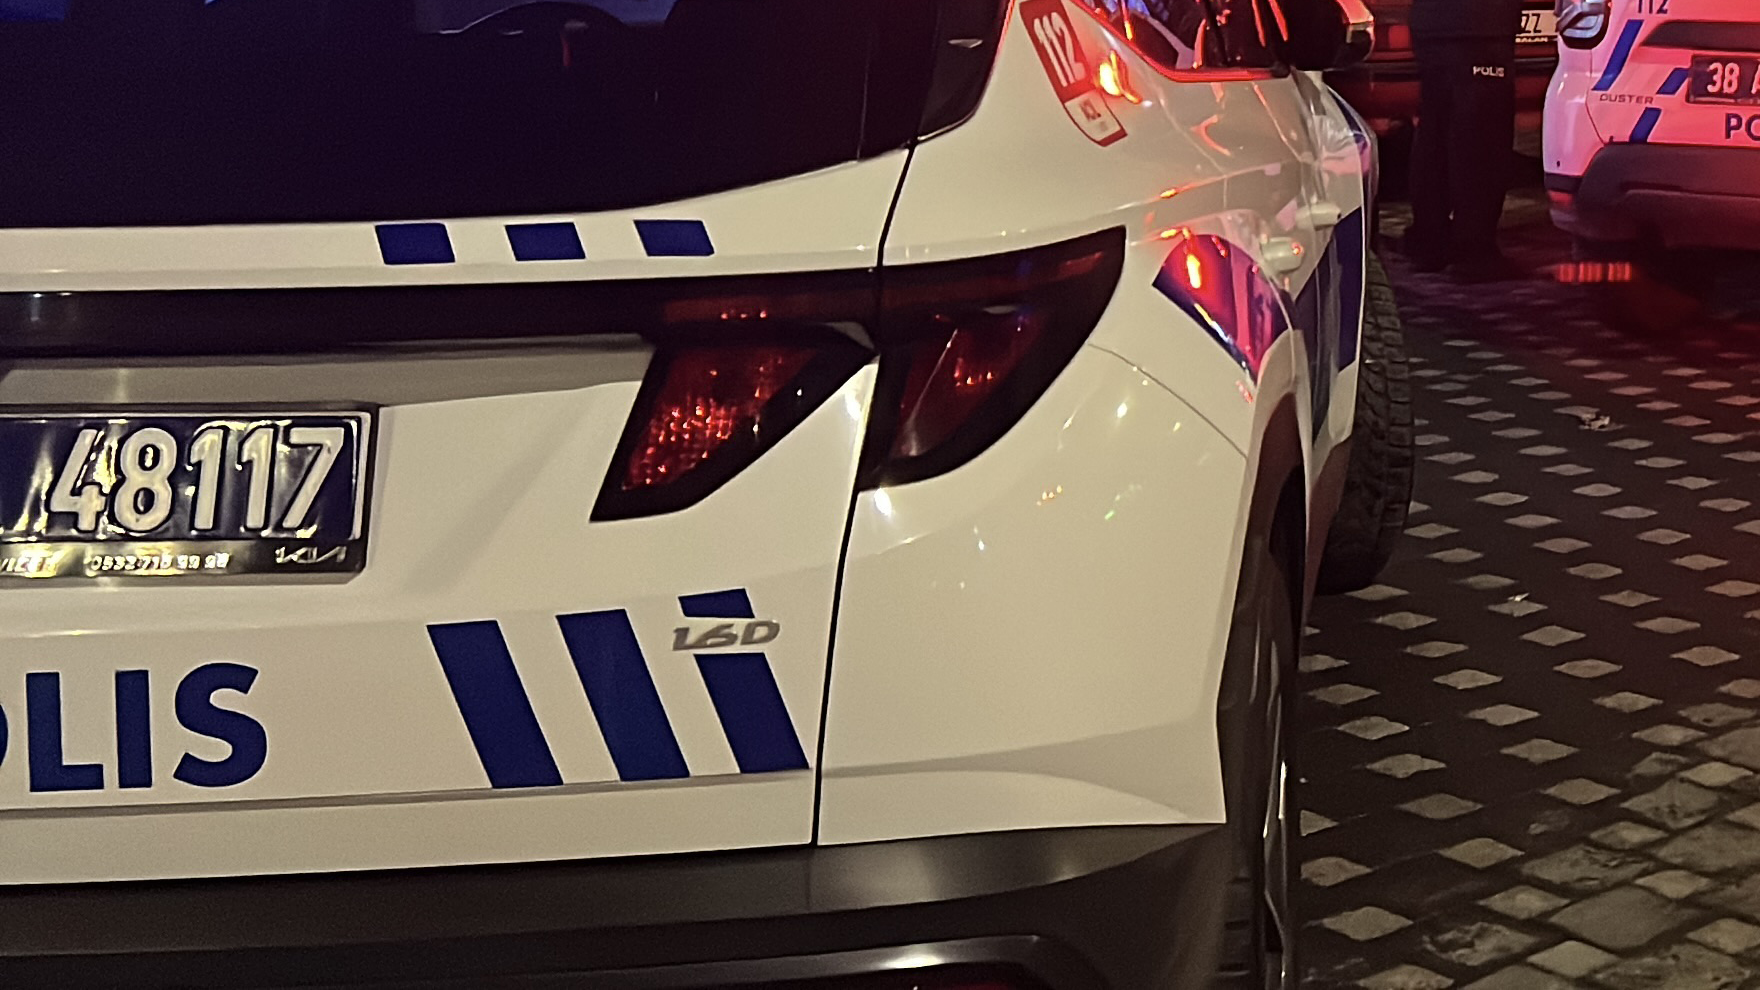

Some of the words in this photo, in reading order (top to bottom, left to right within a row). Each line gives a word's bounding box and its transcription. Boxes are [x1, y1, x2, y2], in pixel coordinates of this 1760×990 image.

[1033, 11, 1087, 88] 112
[1706, 62, 1740, 94] 38
[50, 426, 346, 536] 48117
[0, 661, 268, 793] LIS
